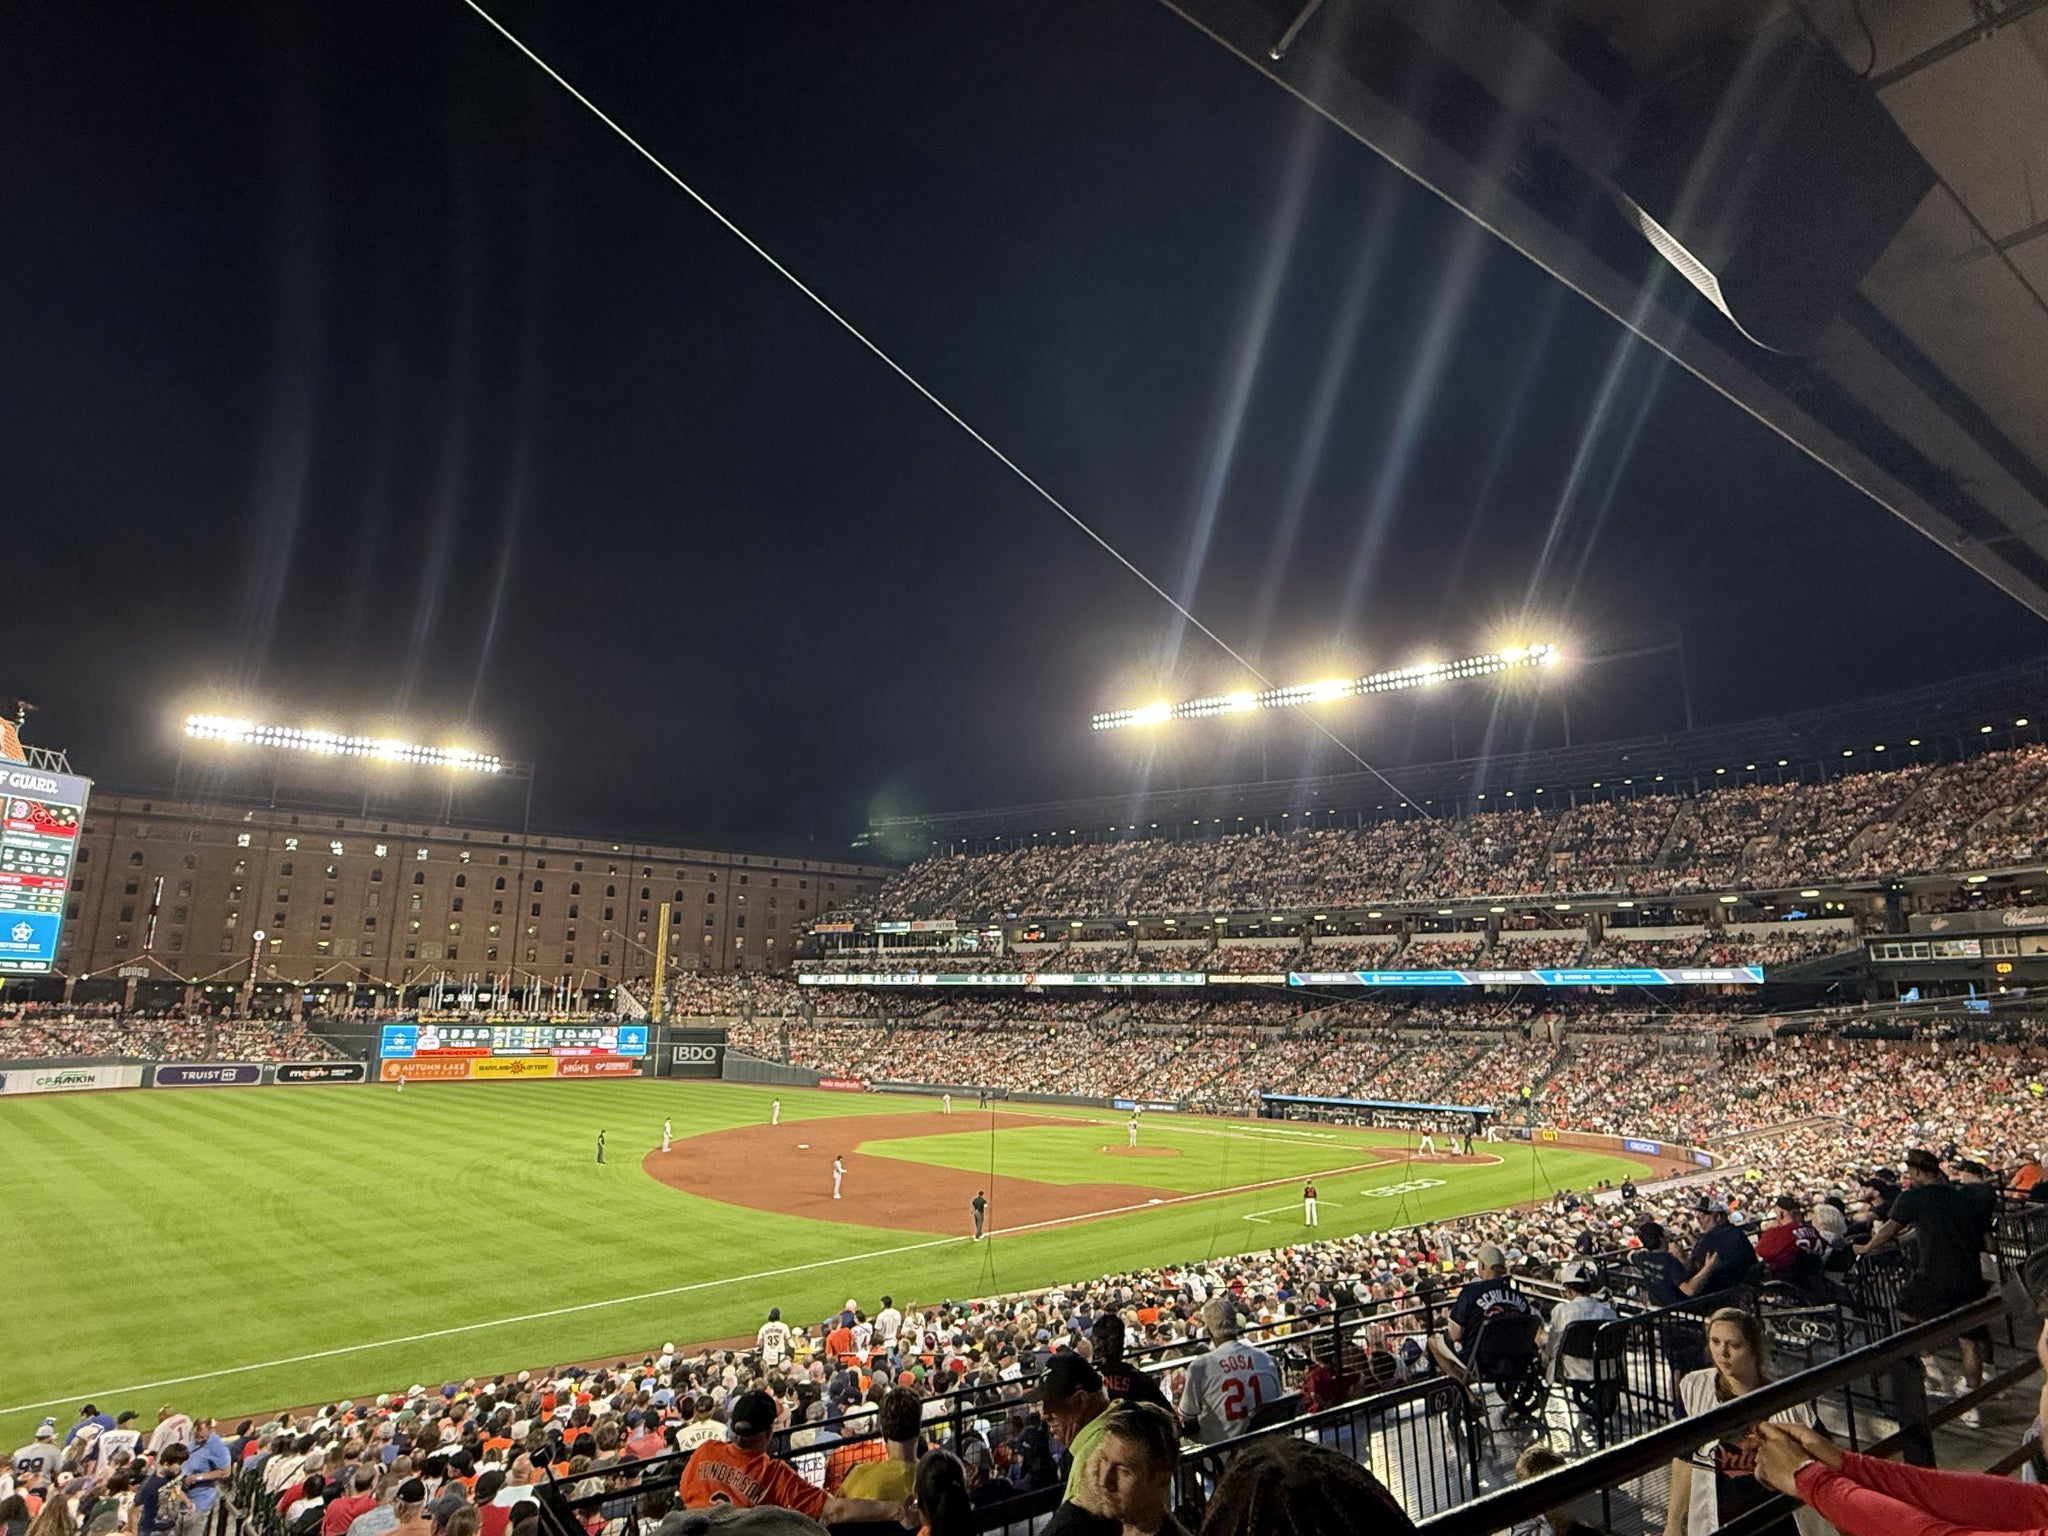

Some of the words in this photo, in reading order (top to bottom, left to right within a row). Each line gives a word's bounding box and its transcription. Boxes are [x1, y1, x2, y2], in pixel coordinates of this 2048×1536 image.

[678, 1046, 717, 1061] BDO
[181, 1071, 220, 1080] TRUIST
[402, 1063, 441, 1072] AUTUMN
[443, 1063, 466, 1071] LAKE
[1630, 1141, 1656, 1152] GEICO
[1360, 1178, 1448, 1198] GEICO
[1475, 1288, 1528, 1314] SCHILLING
[1801, 1321, 1820, 1337] 62
[1219, 1354, 1255, 1374] SOSA
[1221, 1374, 1264, 1423] 21
[696, 1460, 768, 1505] HENDERSON
